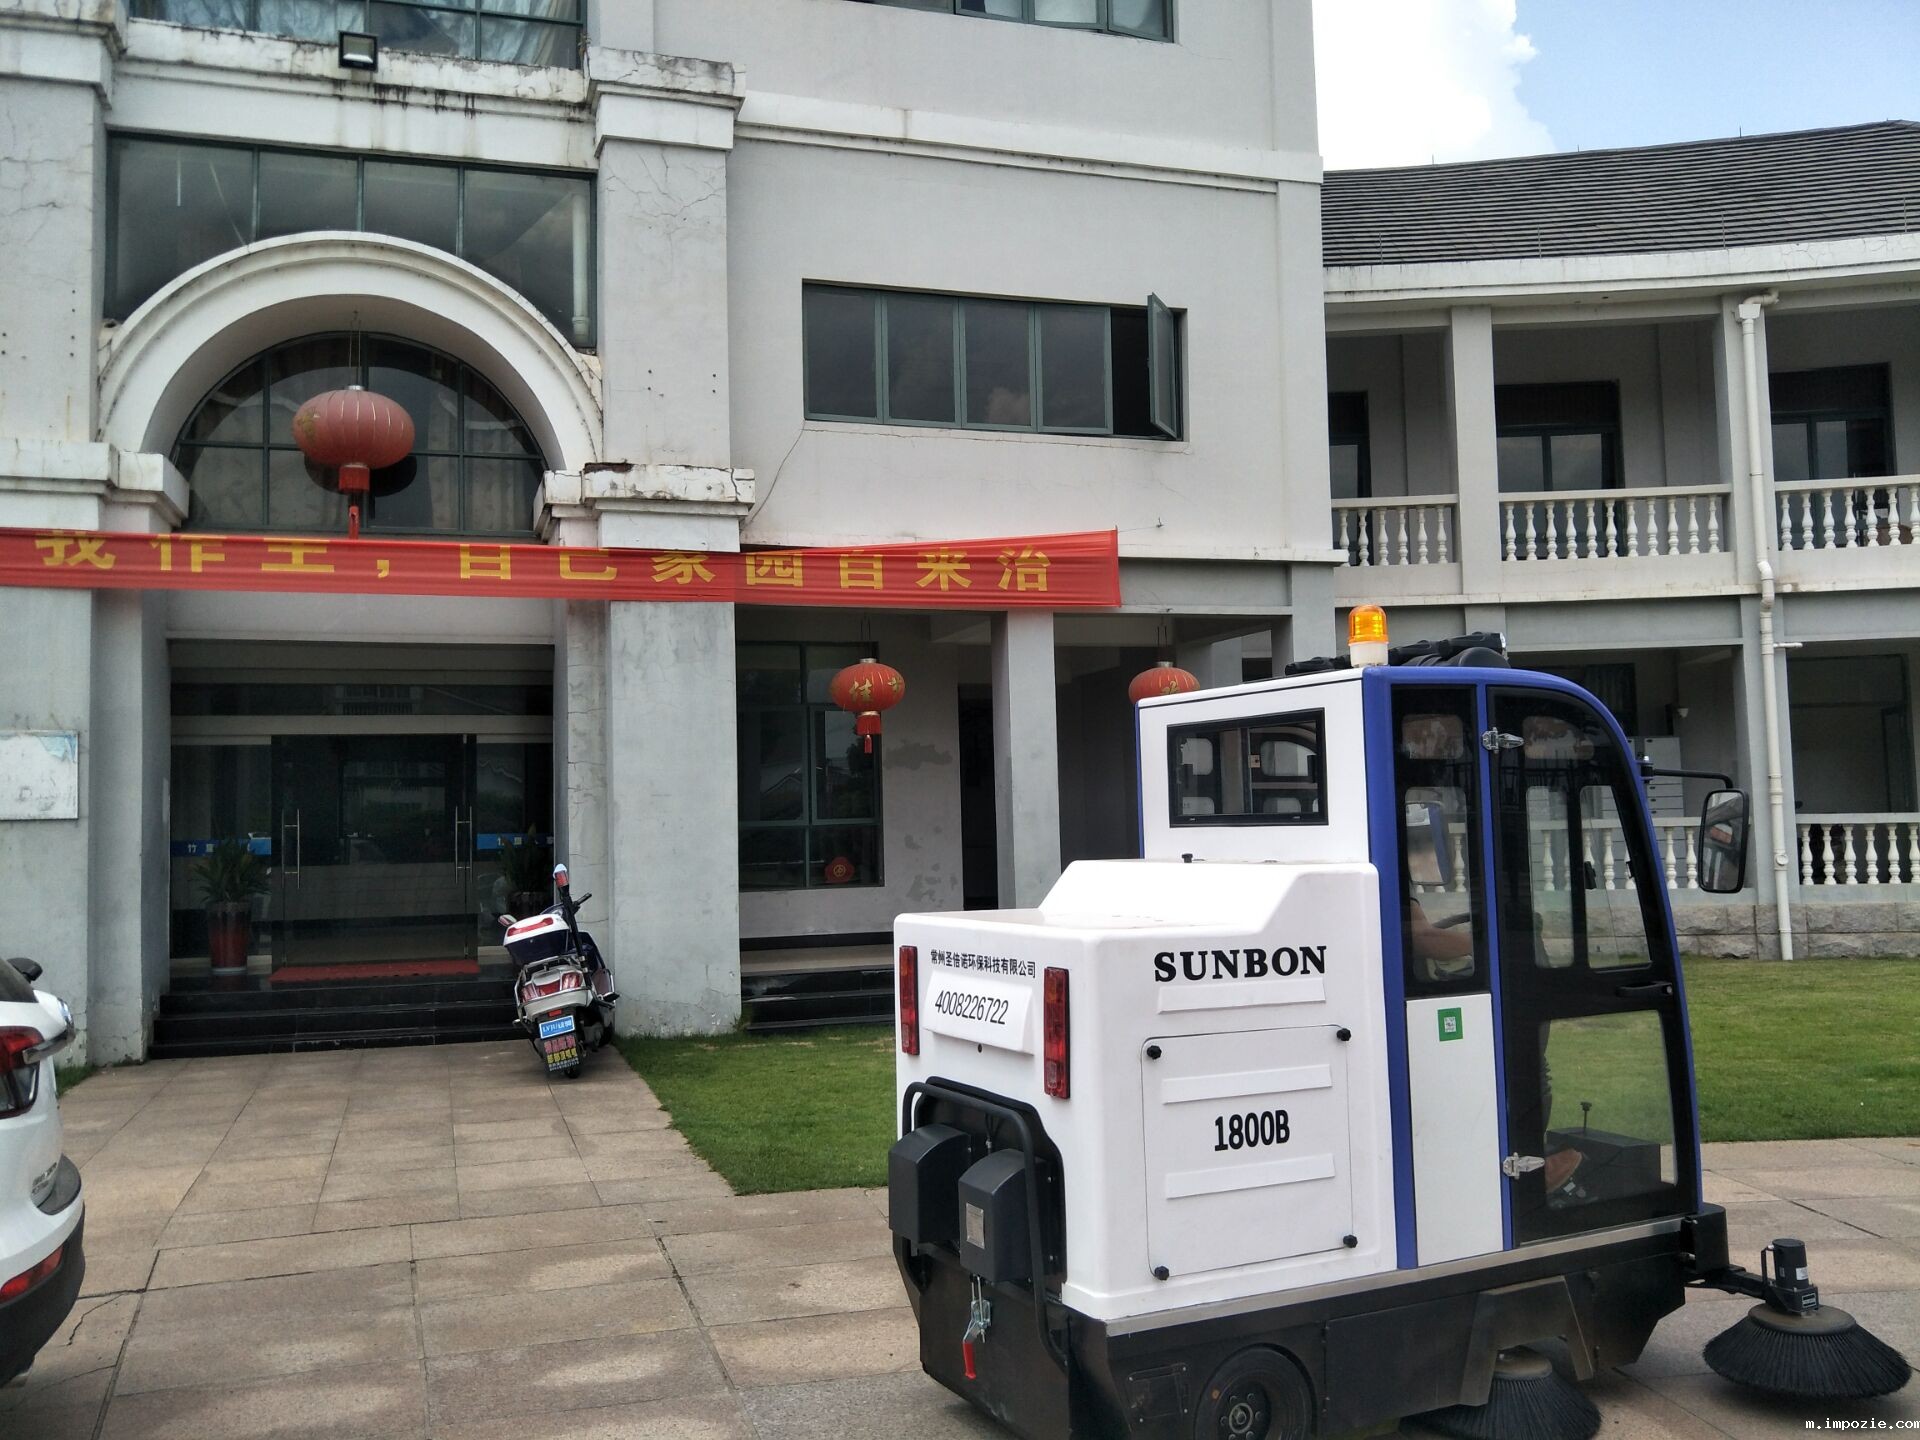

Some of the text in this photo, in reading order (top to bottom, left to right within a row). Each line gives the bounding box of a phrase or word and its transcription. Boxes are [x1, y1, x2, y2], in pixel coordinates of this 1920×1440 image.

[1154, 946, 1327, 982] SUNBON
[935, 990, 1009, 1025] 4008226722
[1214, 1110, 1290, 1151] 1800B
